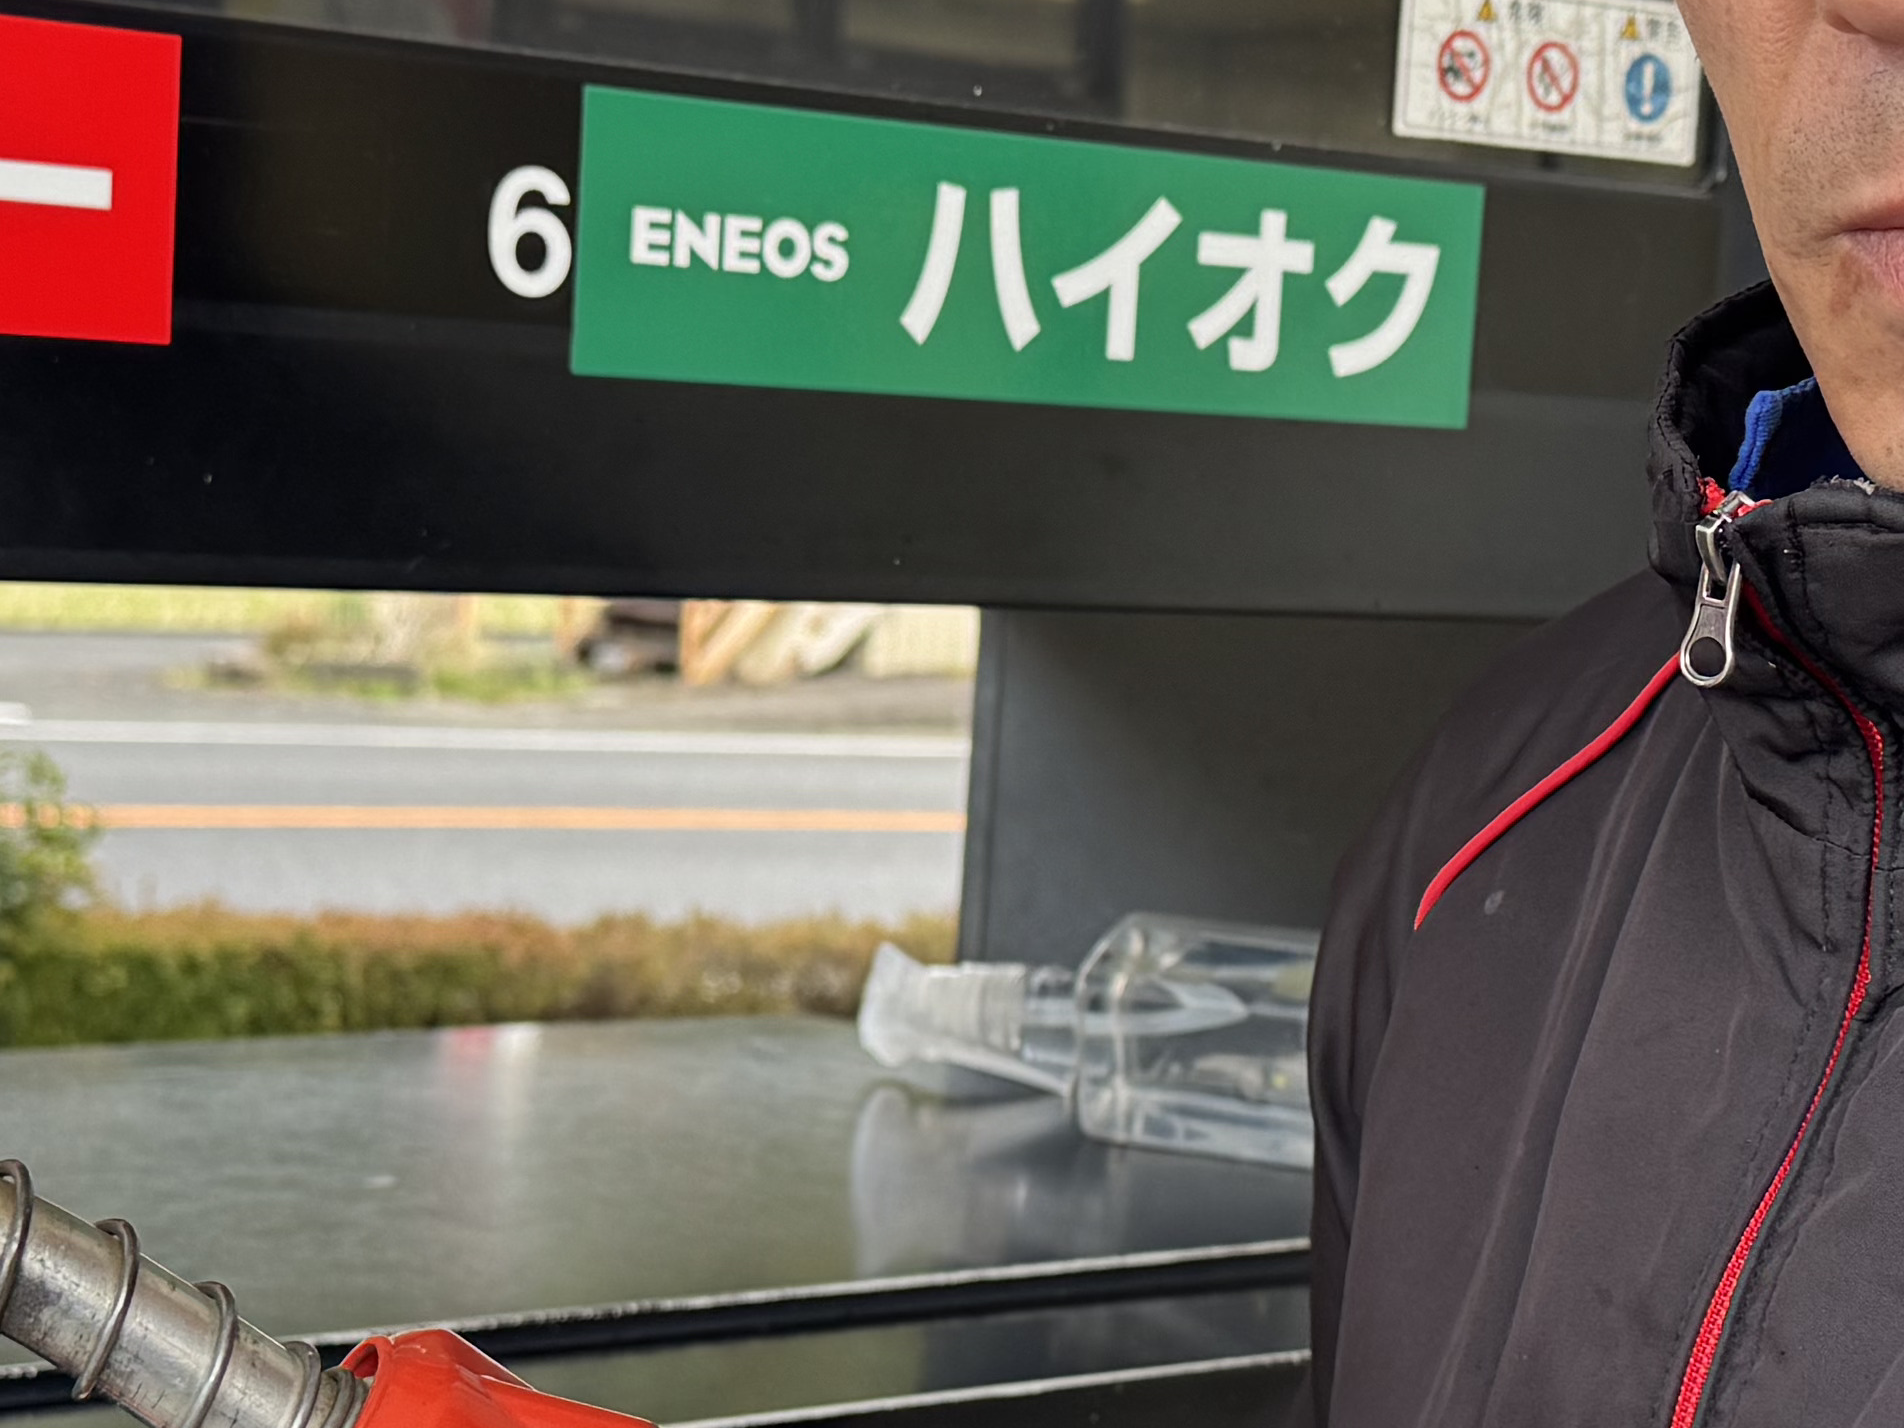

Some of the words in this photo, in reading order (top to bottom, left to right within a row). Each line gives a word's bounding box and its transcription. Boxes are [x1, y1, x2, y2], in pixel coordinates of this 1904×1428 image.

[486, 164, 573, 299] 6
[627, 205, 851, 282] ENEOS
[899, 180, 1440, 378] ハイオク
